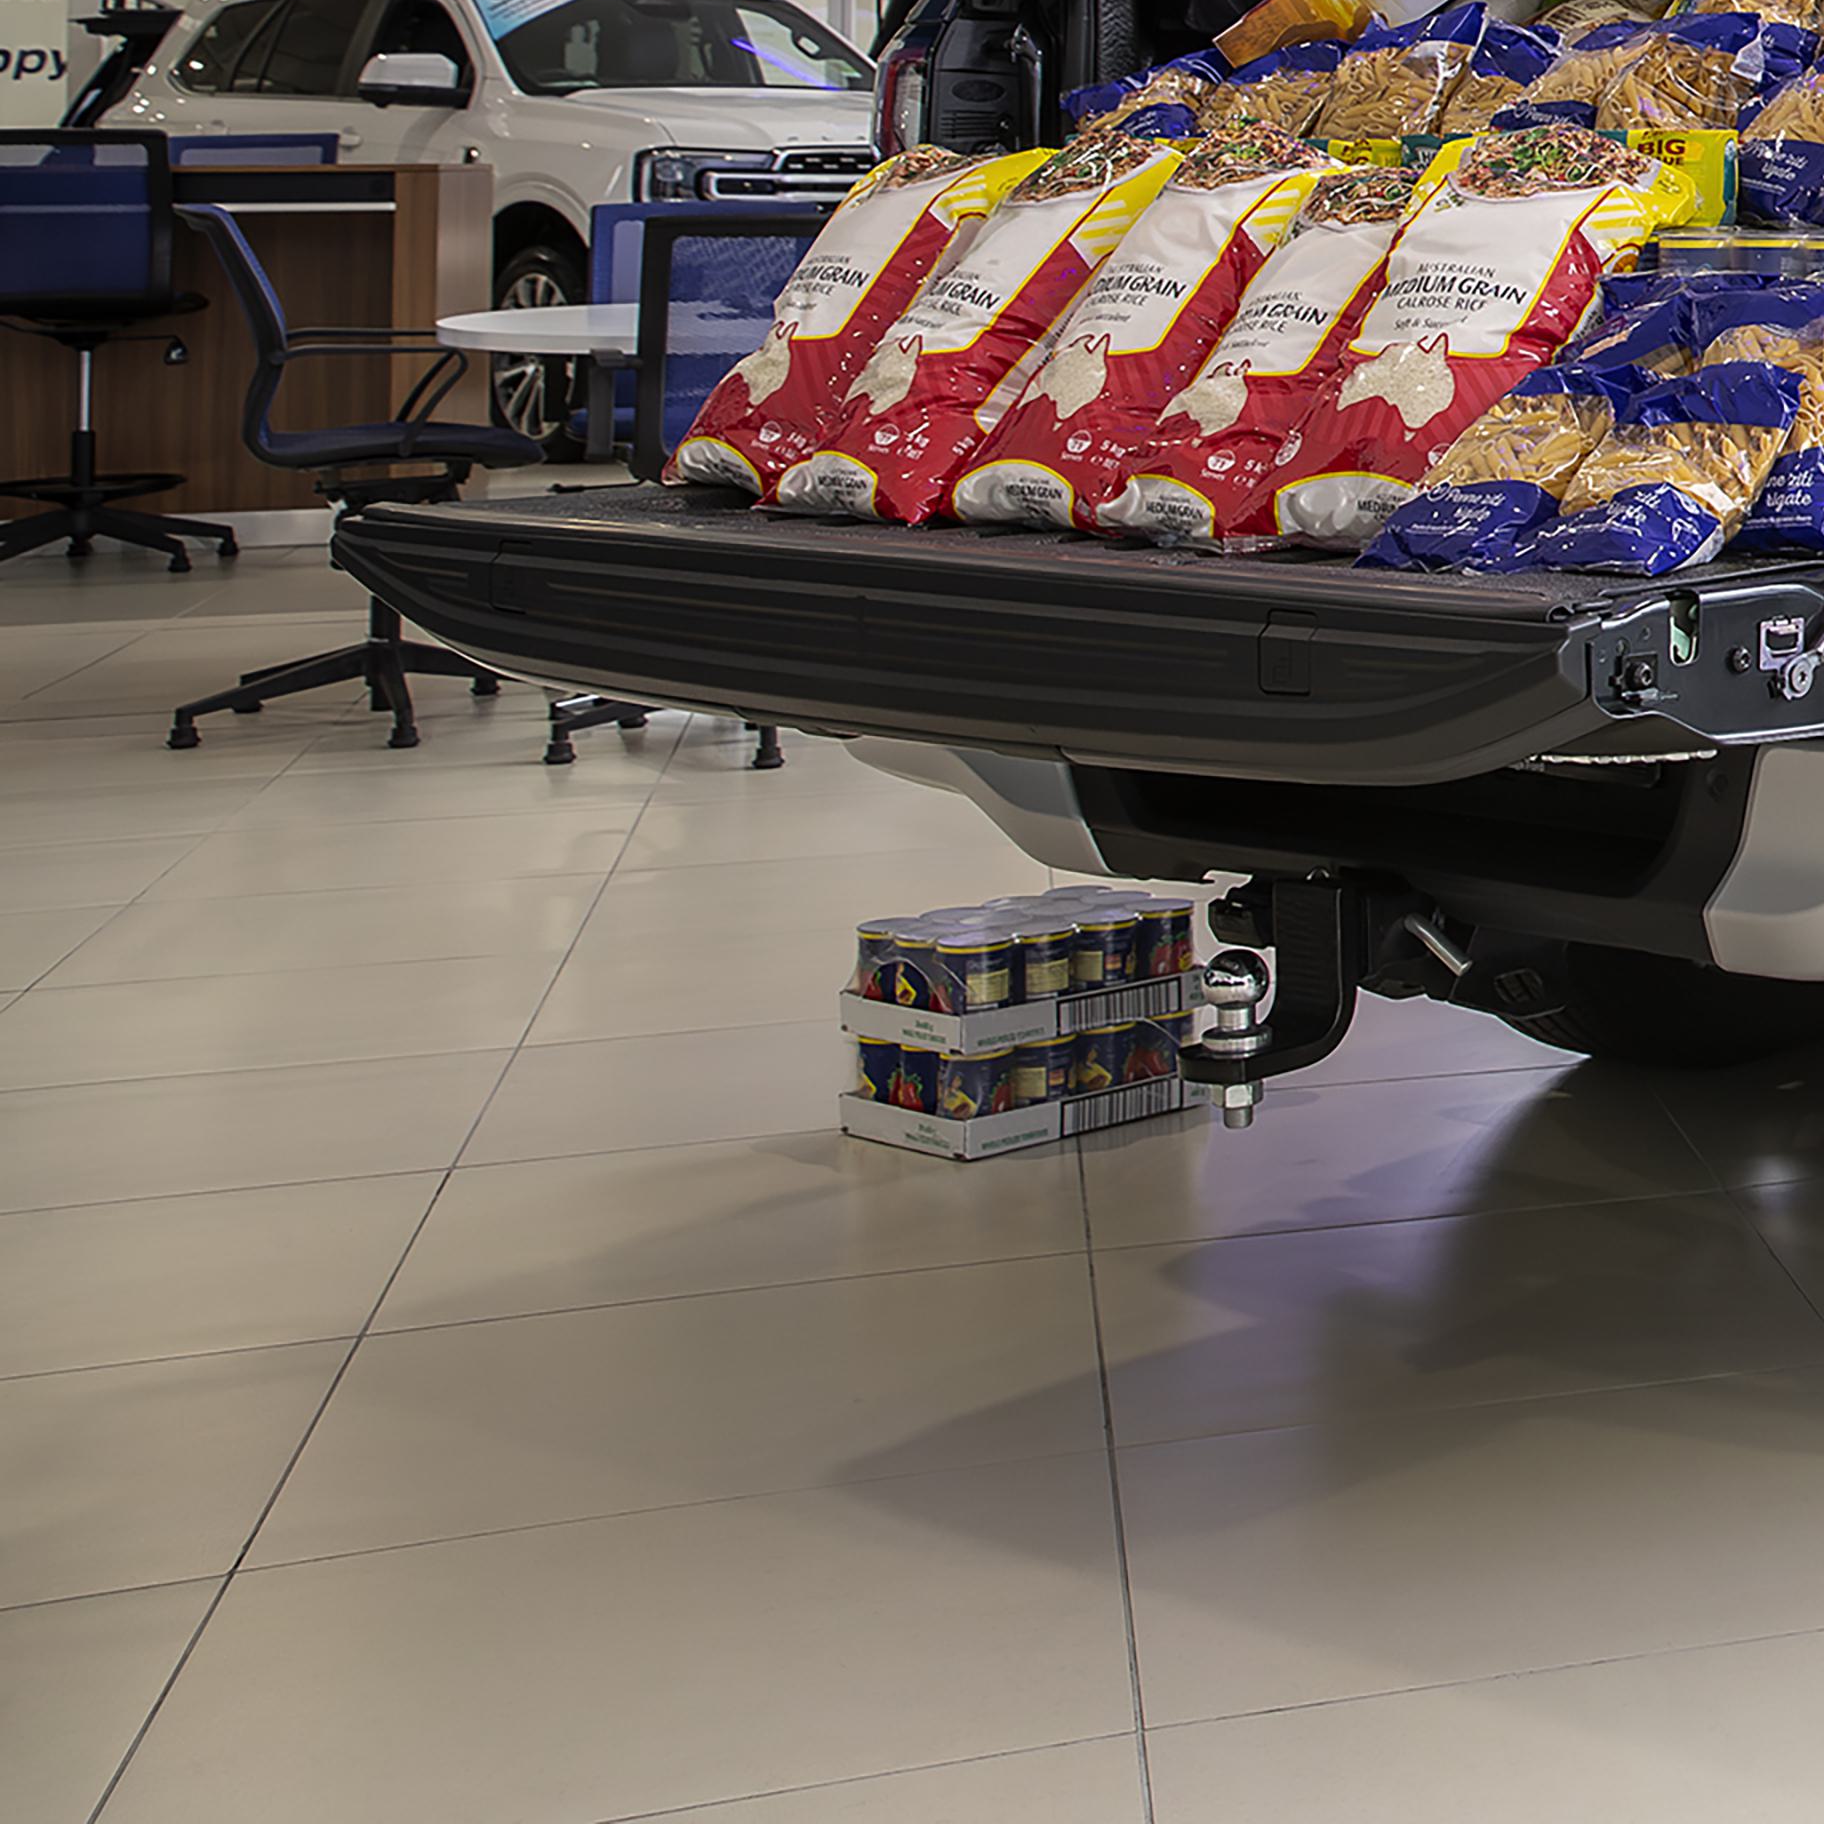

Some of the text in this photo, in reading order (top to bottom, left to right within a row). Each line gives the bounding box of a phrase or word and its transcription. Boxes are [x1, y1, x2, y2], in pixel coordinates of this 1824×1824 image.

[1638, 139, 1686, 155] BIG
[819, 264, 871, 289] GRAIN
[1417, 262, 1496, 278] AUSTRALIAN
[950, 281, 1001, 310] GRAIN
[1129, 277, 1188, 299] GRAIN
[1457, 276, 1528, 305] GRAIN
[1266, 302, 1329, 327] GRAIN
[1396, 295, 1451, 310] CALROSE
[1787, 463, 1815, 488] ziti
[1765, 489, 1813, 513] rigate
